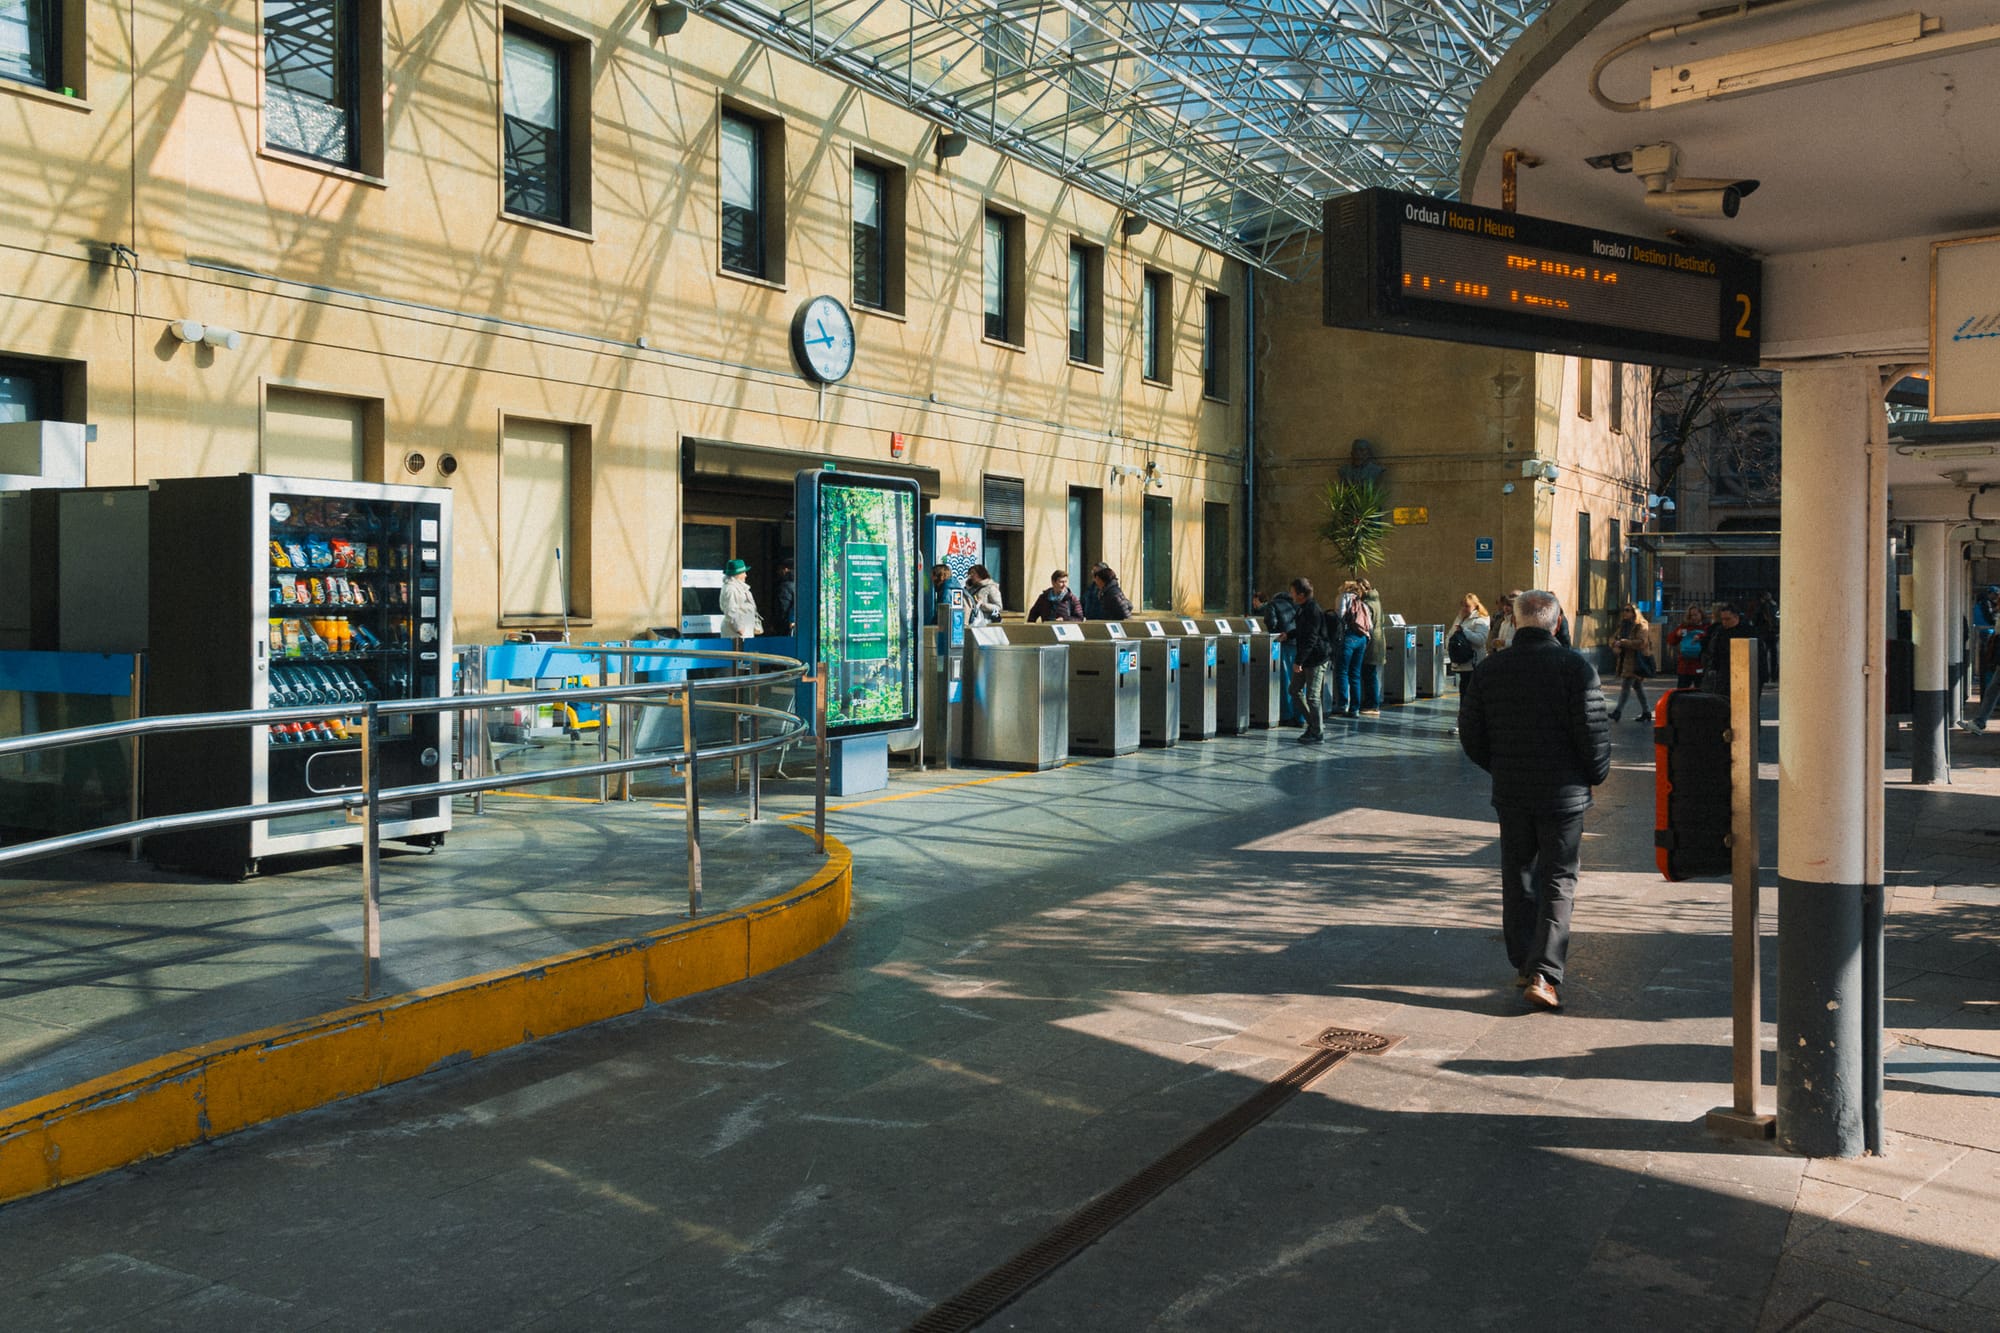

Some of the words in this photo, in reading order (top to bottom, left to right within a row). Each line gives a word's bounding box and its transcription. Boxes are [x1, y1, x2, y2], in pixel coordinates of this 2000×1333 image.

[1405, 203, 1440, 224] Ordua
[1449, 211, 1475, 231] Hora
[1484, 217, 1516, 239] Heure
[1592, 239, 1626, 259] Norako
[1634, 246, 1667, 266] Destino
[1735, 293, 1752, 339] 2
